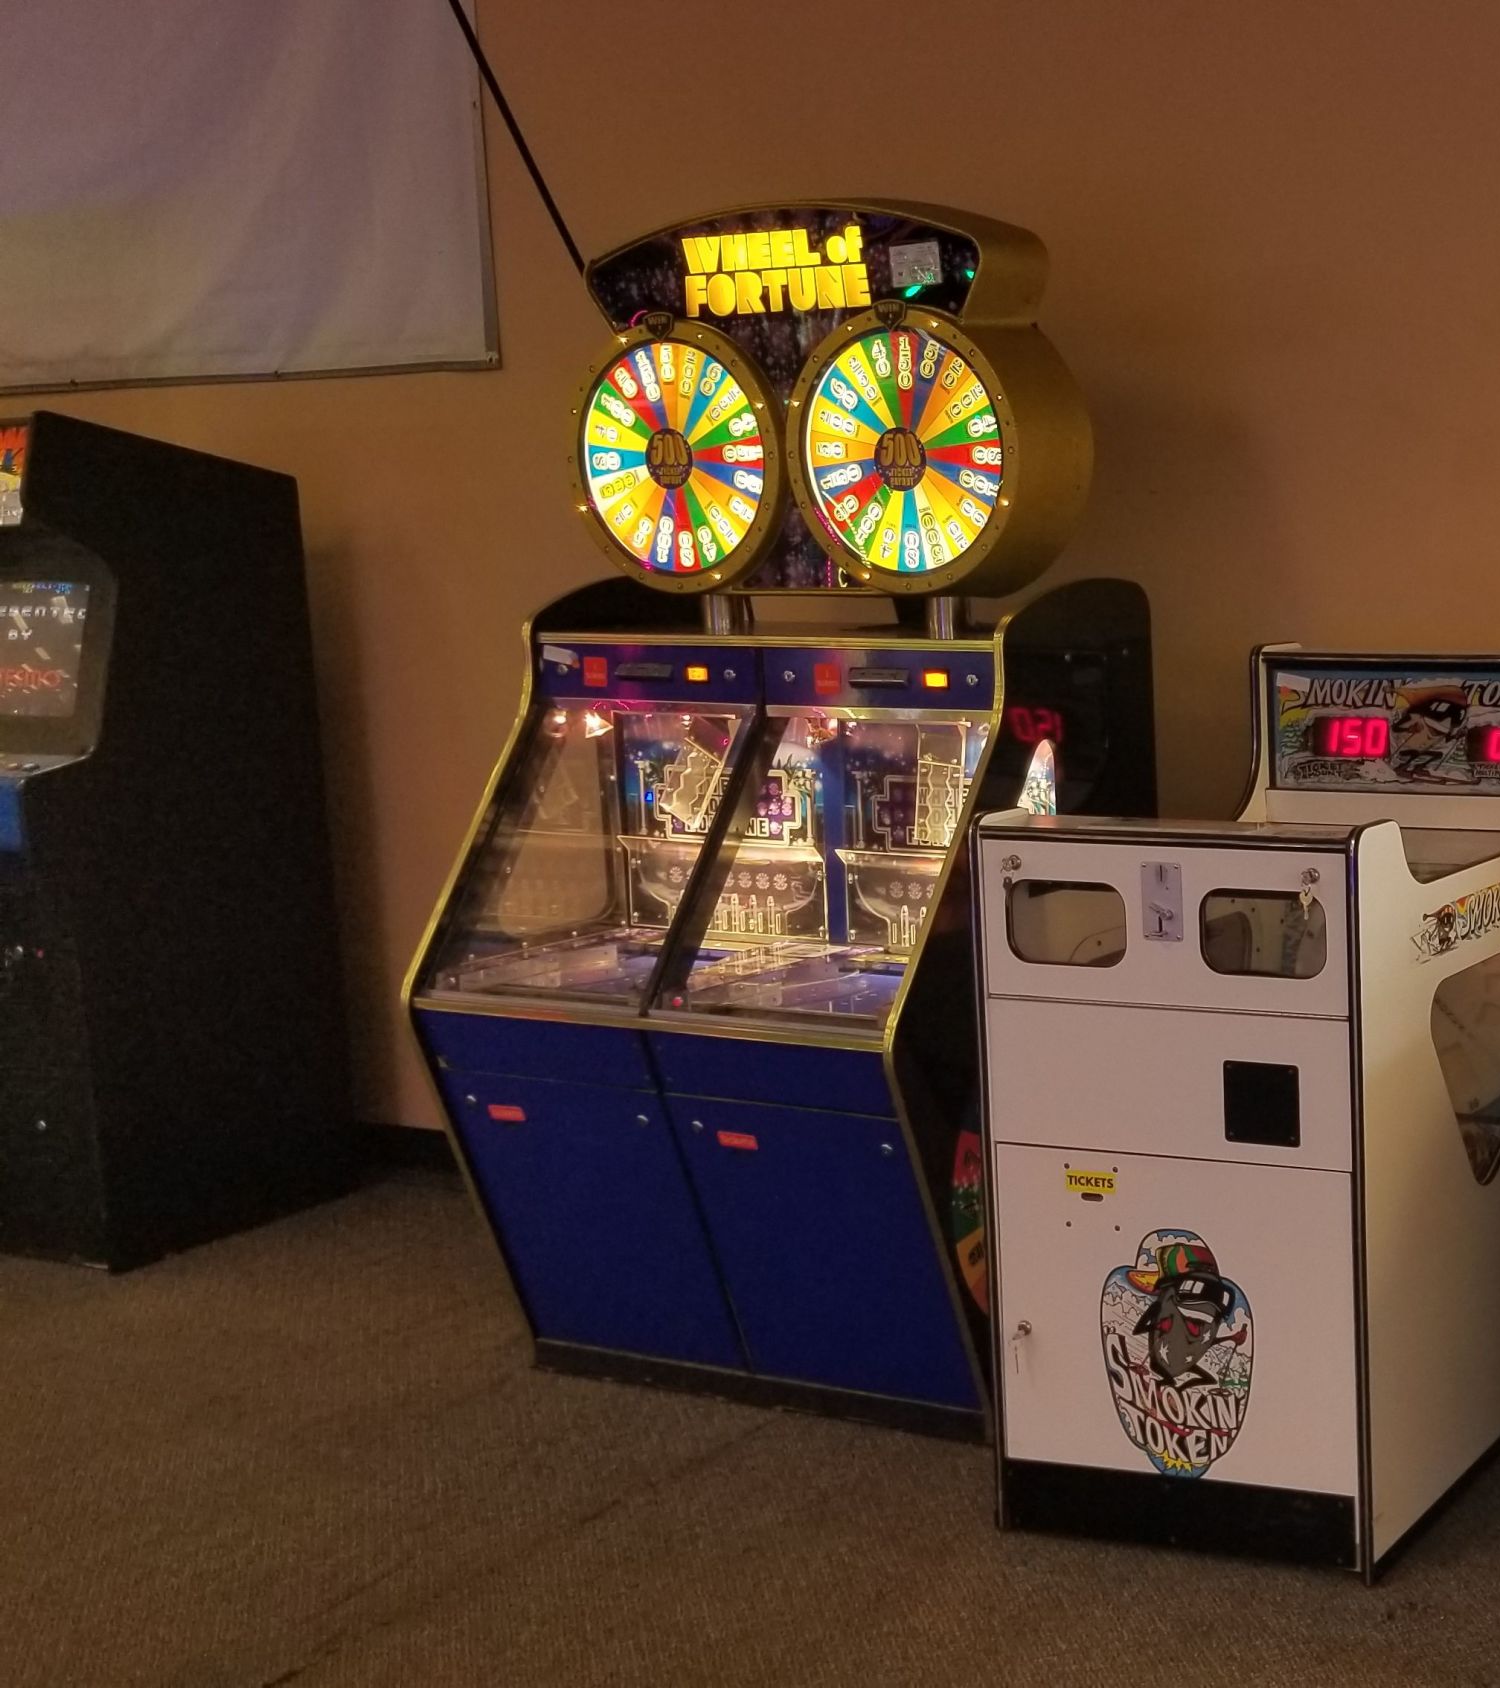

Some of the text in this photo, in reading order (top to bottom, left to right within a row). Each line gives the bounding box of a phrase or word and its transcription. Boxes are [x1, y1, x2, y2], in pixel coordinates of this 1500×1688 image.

[681, 225, 863, 274] WHEEL of
[685, 264, 871, 317] FORTUNE
[898, 334, 913, 389] 150
[920, 340, 939, 378] 50
[651, 434, 688, 465] 500
[880, 433, 921, 466] 500
[8, 629, 33, 640] BY
[1328, 719, 1387, 754] 150
[1066, 1174, 1114, 1189] TICKETS
